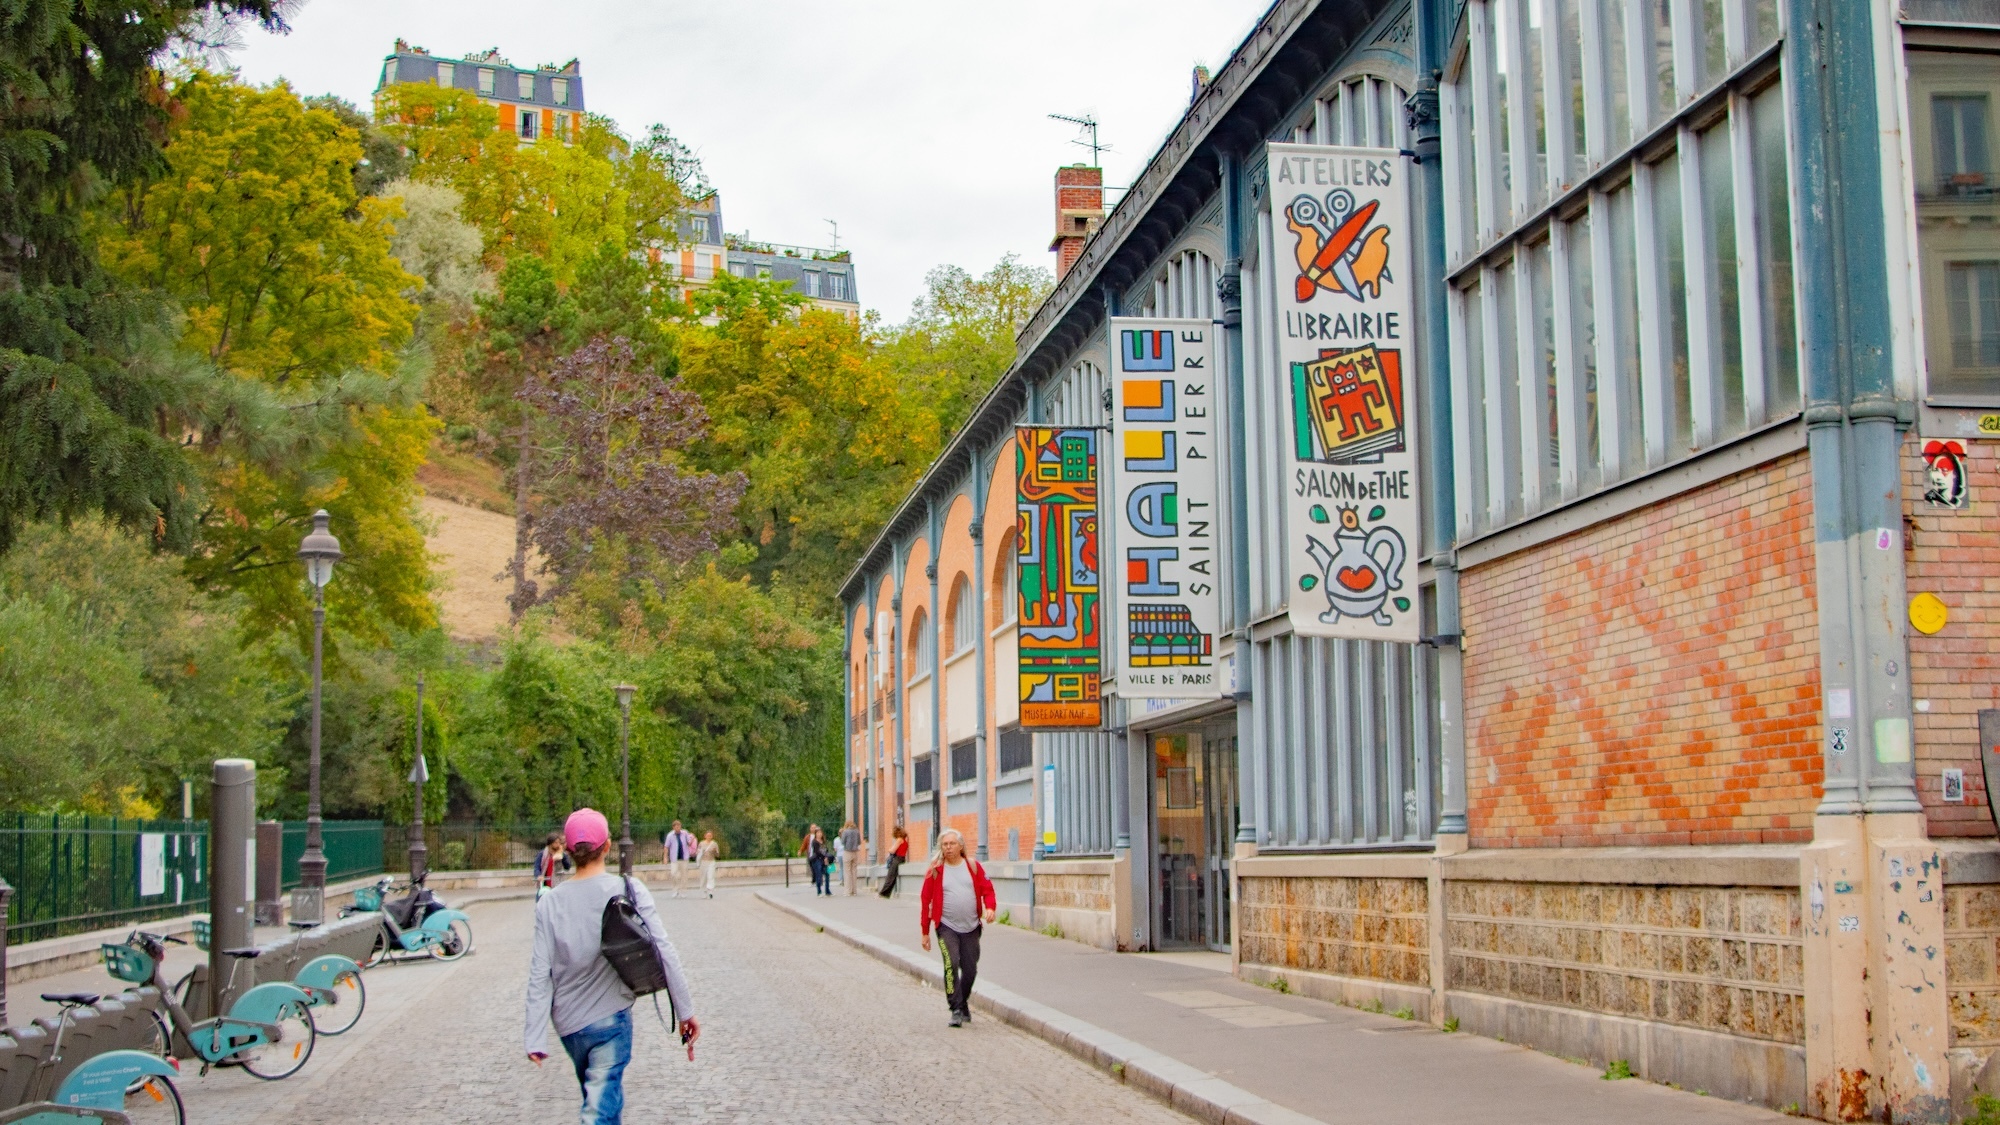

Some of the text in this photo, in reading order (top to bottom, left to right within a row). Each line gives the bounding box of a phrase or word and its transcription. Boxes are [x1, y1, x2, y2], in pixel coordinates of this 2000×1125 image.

[1278, 156, 1392, 187] ATELIERS
[1287, 309, 1400, 341] LIBRAIRIE
[1120, 329, 1180, 597] HALLE
[1181, 330, 1212, 597] SAINT PIERRE
[1295, 468, 1356, 500] SALON
[1373, 470, 1410, 499] THE
[1128, 673, 1212, 685] VILLE DE PARIS
